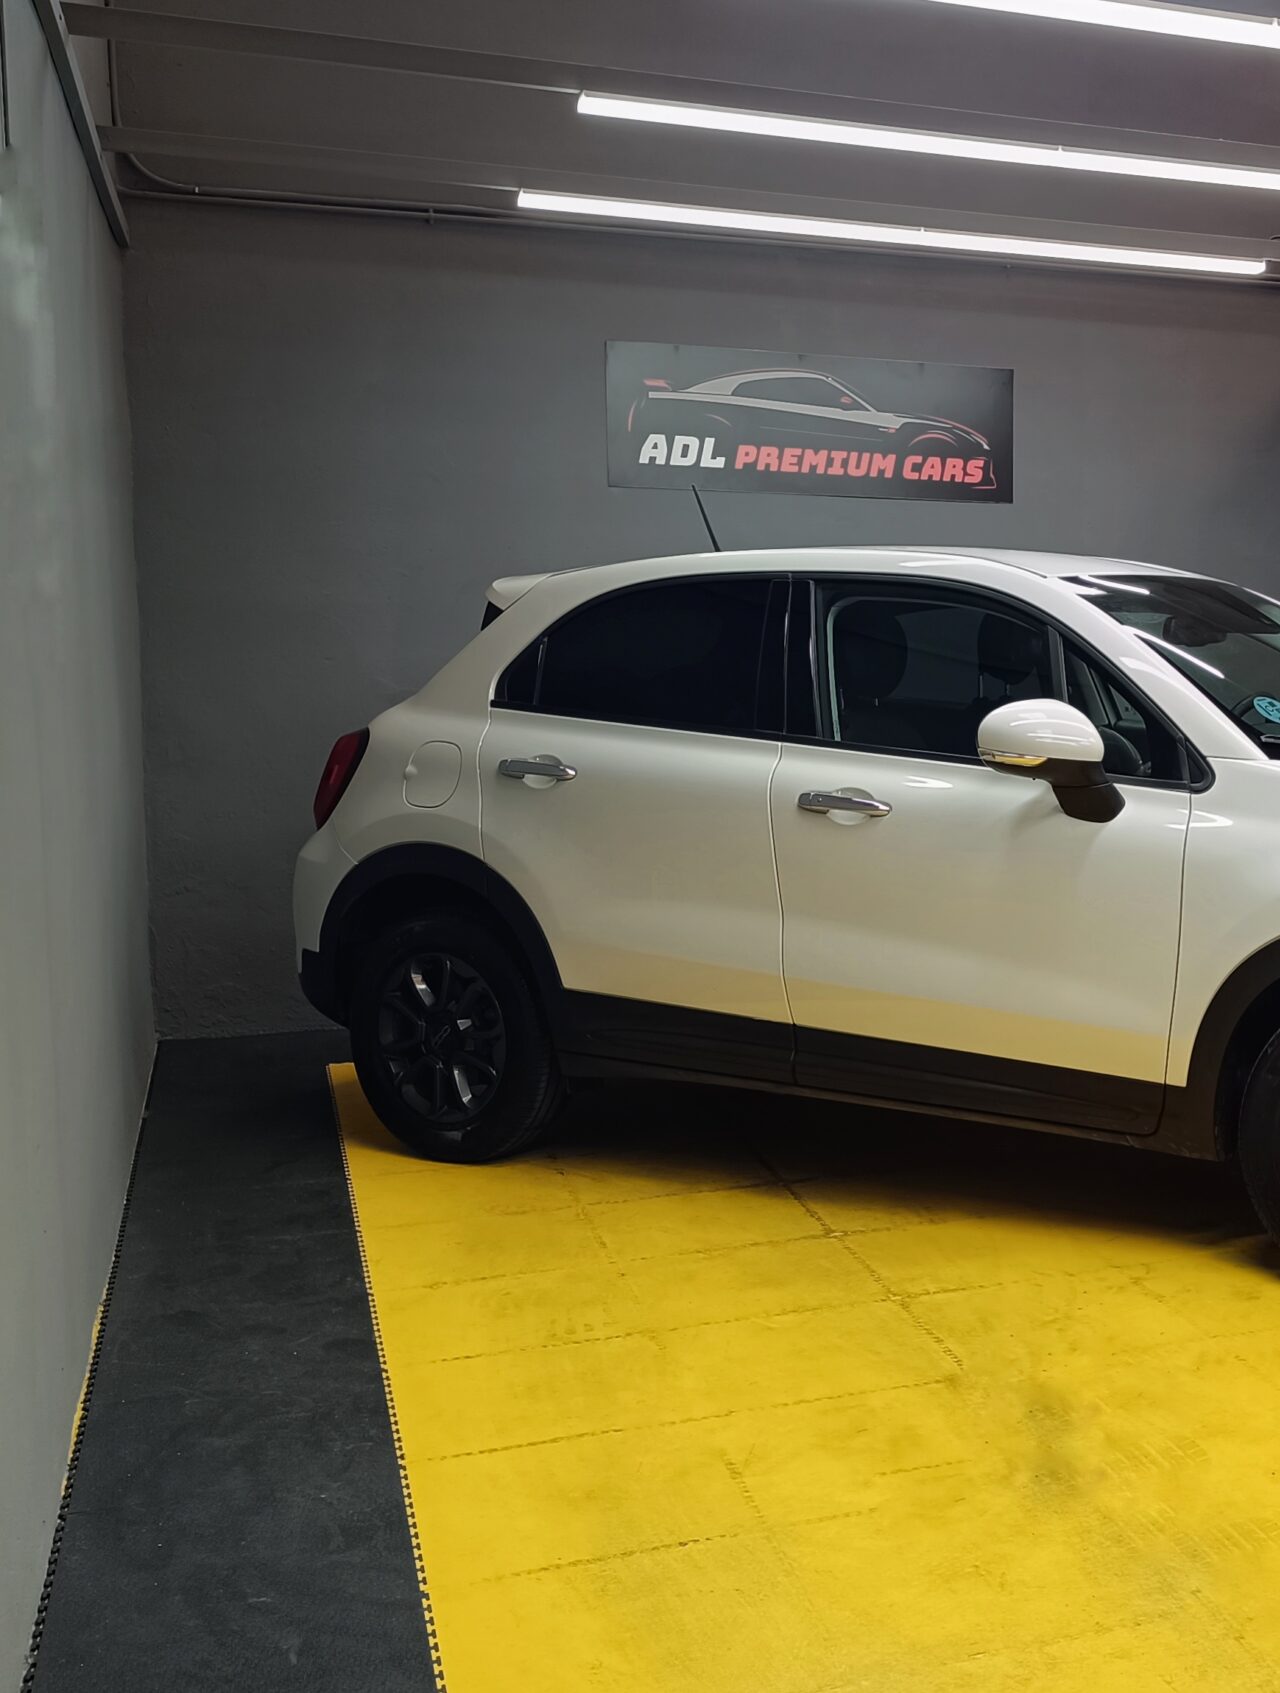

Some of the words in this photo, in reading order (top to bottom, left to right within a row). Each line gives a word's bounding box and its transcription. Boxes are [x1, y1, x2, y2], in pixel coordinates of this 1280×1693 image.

[638, 433, 726, 469] ADL
[735, 444, 897, 478] PREMIUM
[902, 454, 985, 484] CARS
